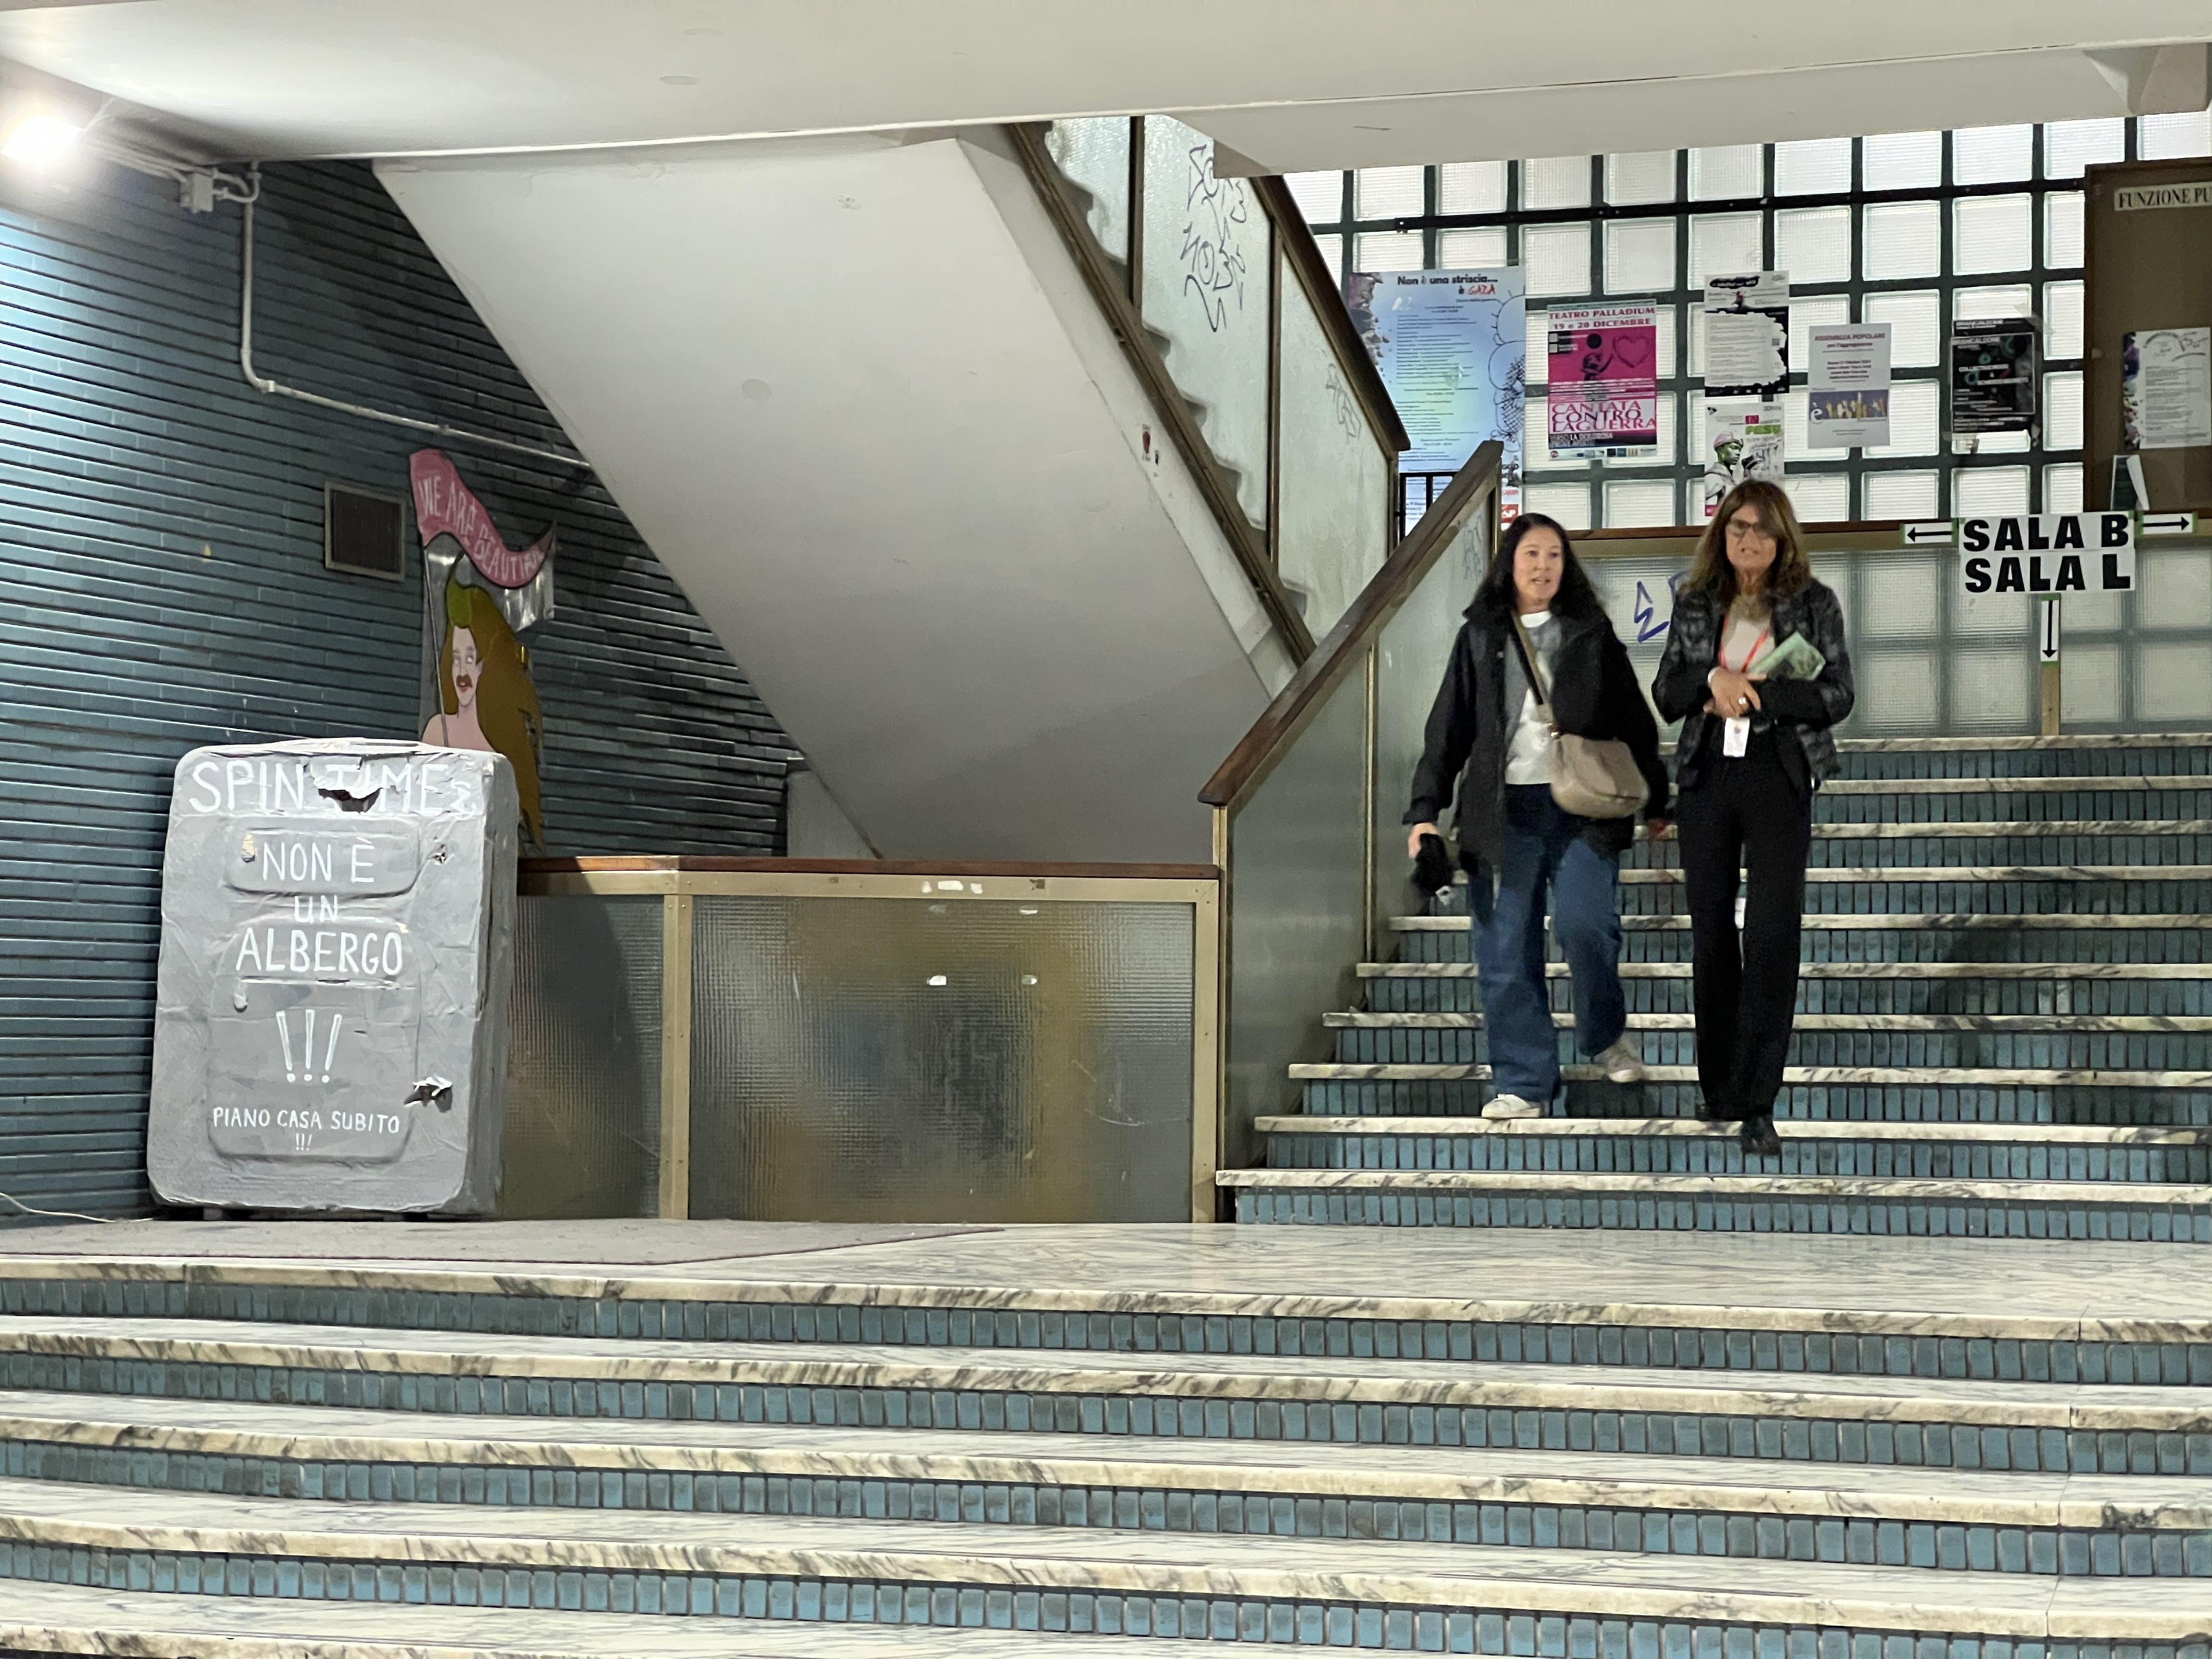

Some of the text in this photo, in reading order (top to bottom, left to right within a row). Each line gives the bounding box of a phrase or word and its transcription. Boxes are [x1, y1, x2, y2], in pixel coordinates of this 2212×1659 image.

[2119, 188, 2190, 208] FUNZIONE
[1398, 276, 1418, 285] Non
[1468, 284, 1496, 295] GAZA
[1549, 307, 1655, 320] TEATRO PALLADIUM
[1594, 318, 1651, 328] DICEMBRE
[1551, 400, 1641, 414] CANTATA
[1551, 409, 1641, 424] CONTRO
[419, 476, 441, 517] WE
[445, 480, 477, 546] ARE
[1963, 514, 2129, 552] SALA B
[1964, 554, 2131, 593] SALA L
[189, 760, 305, 814] SPIN
[262, 836, 376, 883] NON È
[293, 895, 338, 923] UN
[235, 928, 403, 975] ALBERGO
[212, 1106, 400, 1134] PIANO CASA SUBITO
